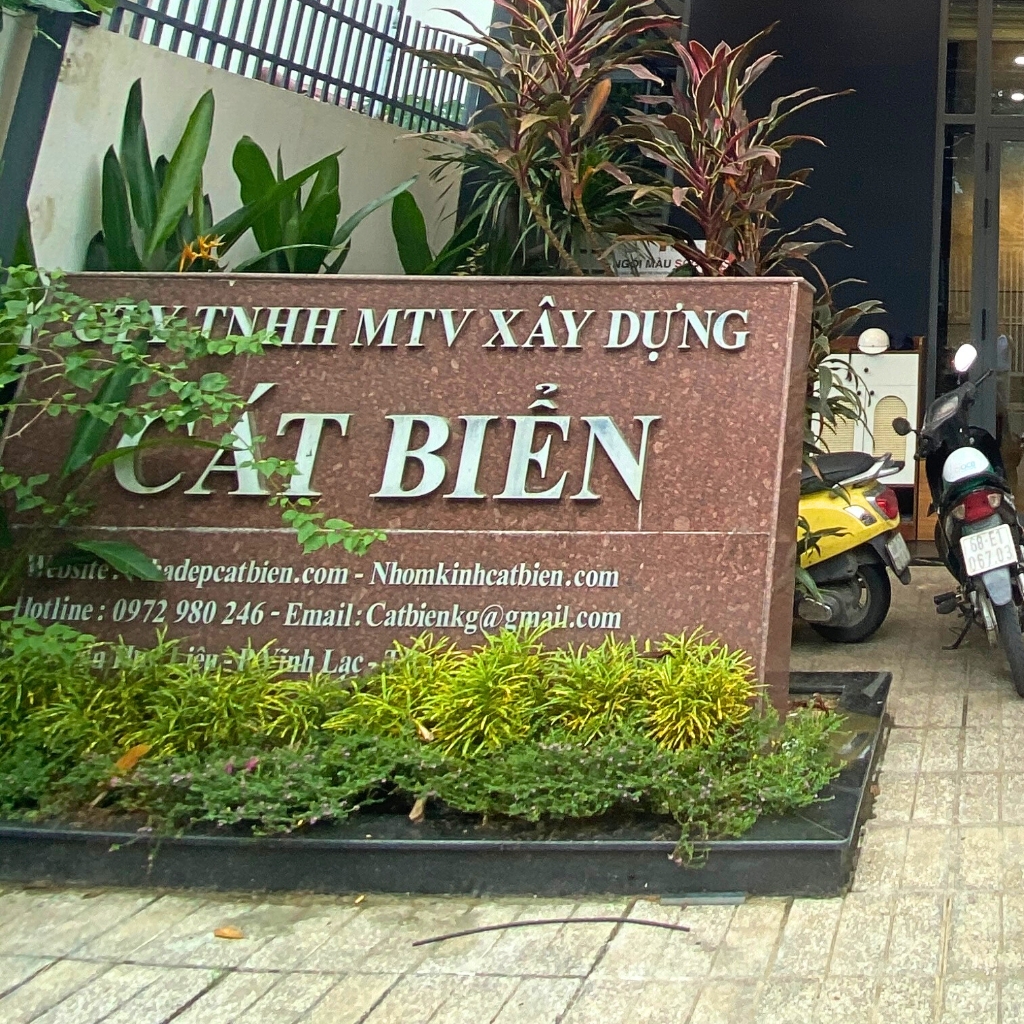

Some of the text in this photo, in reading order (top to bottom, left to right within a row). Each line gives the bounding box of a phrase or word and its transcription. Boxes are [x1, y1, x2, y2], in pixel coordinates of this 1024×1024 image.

[195, 304, 347, 347] TNHH
[349, 308, 477, 348] MTV
[482, 295, 597, 349] XÂY
[603, 302, 751, 363] DỰNG
[113, 382, 662, 502] CÁT BIỂN
[112, 598, 168, 623] 0972
[175, 599, 217, 625] 980
